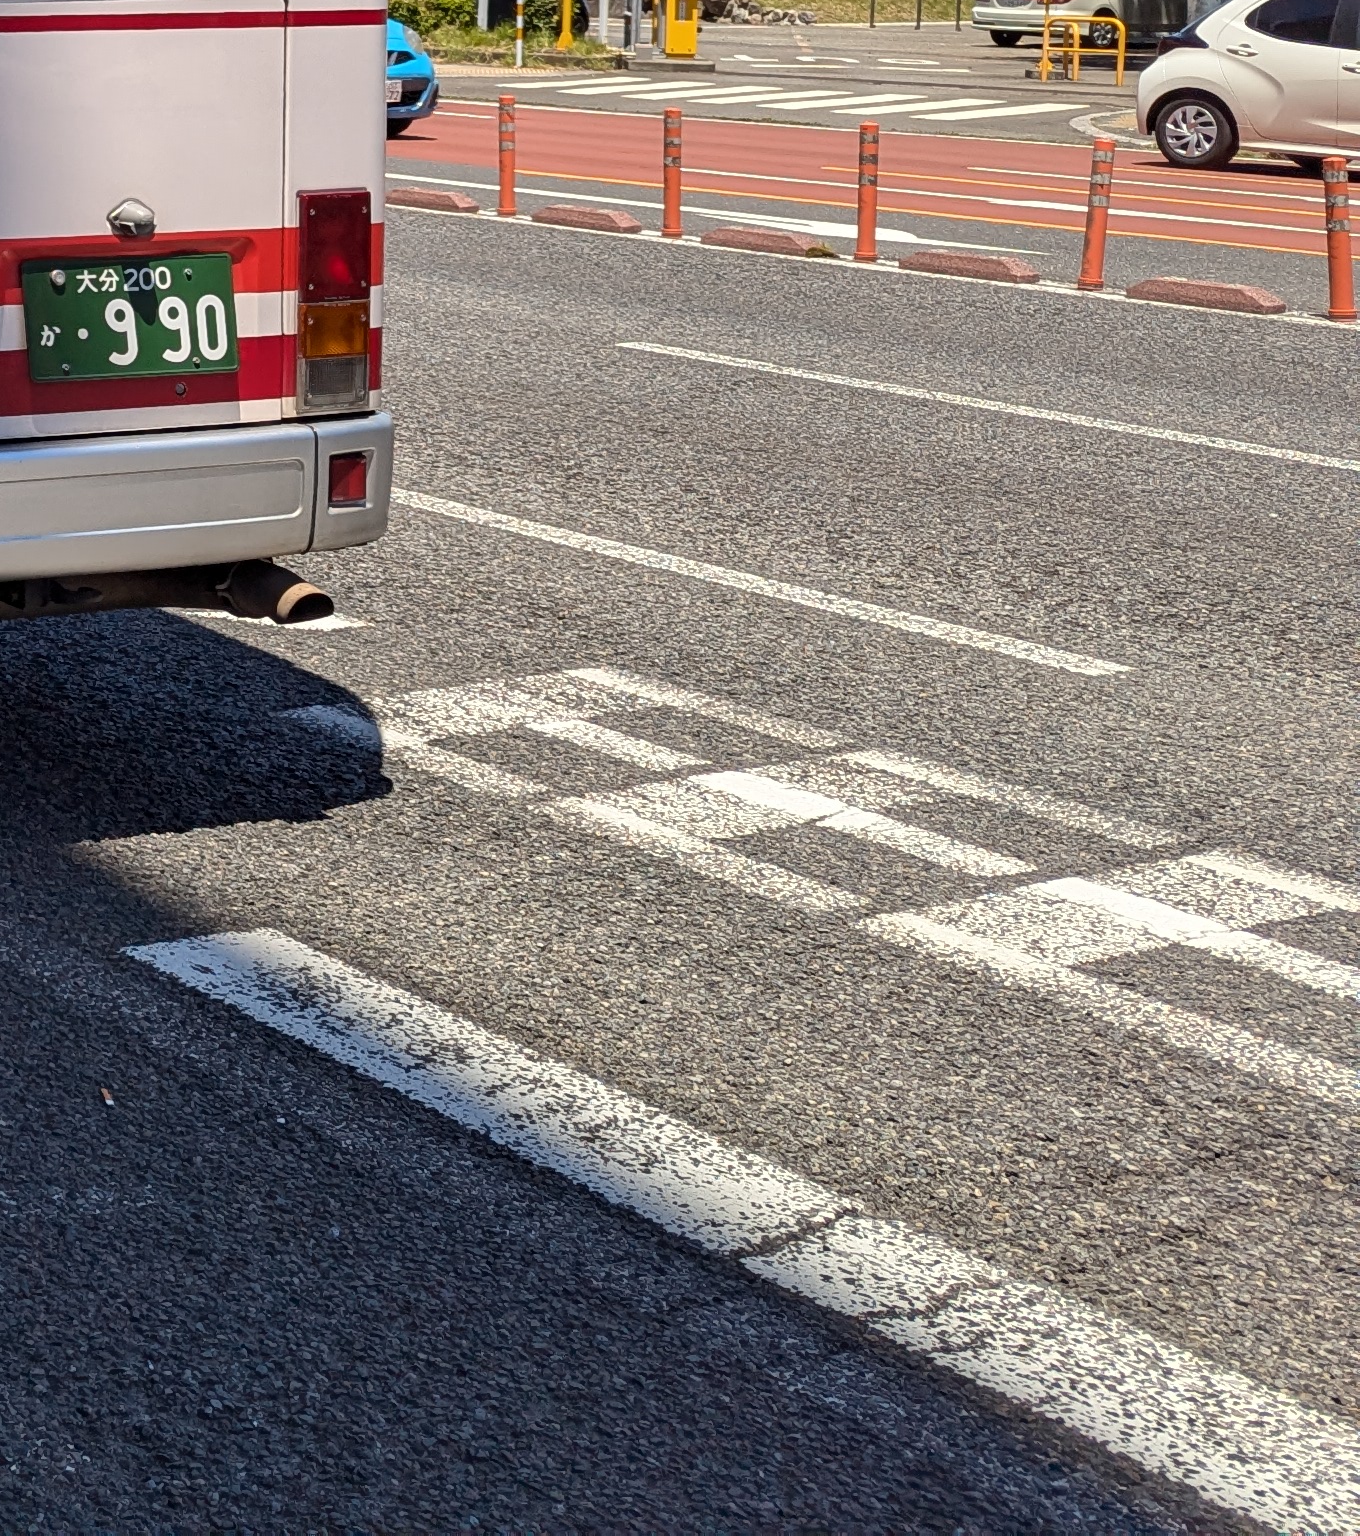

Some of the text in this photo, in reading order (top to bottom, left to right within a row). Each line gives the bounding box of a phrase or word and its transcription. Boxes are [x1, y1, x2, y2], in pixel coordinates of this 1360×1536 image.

[75, 266, 172, 293] 大分 200
[40, 324, 61, 348] か
